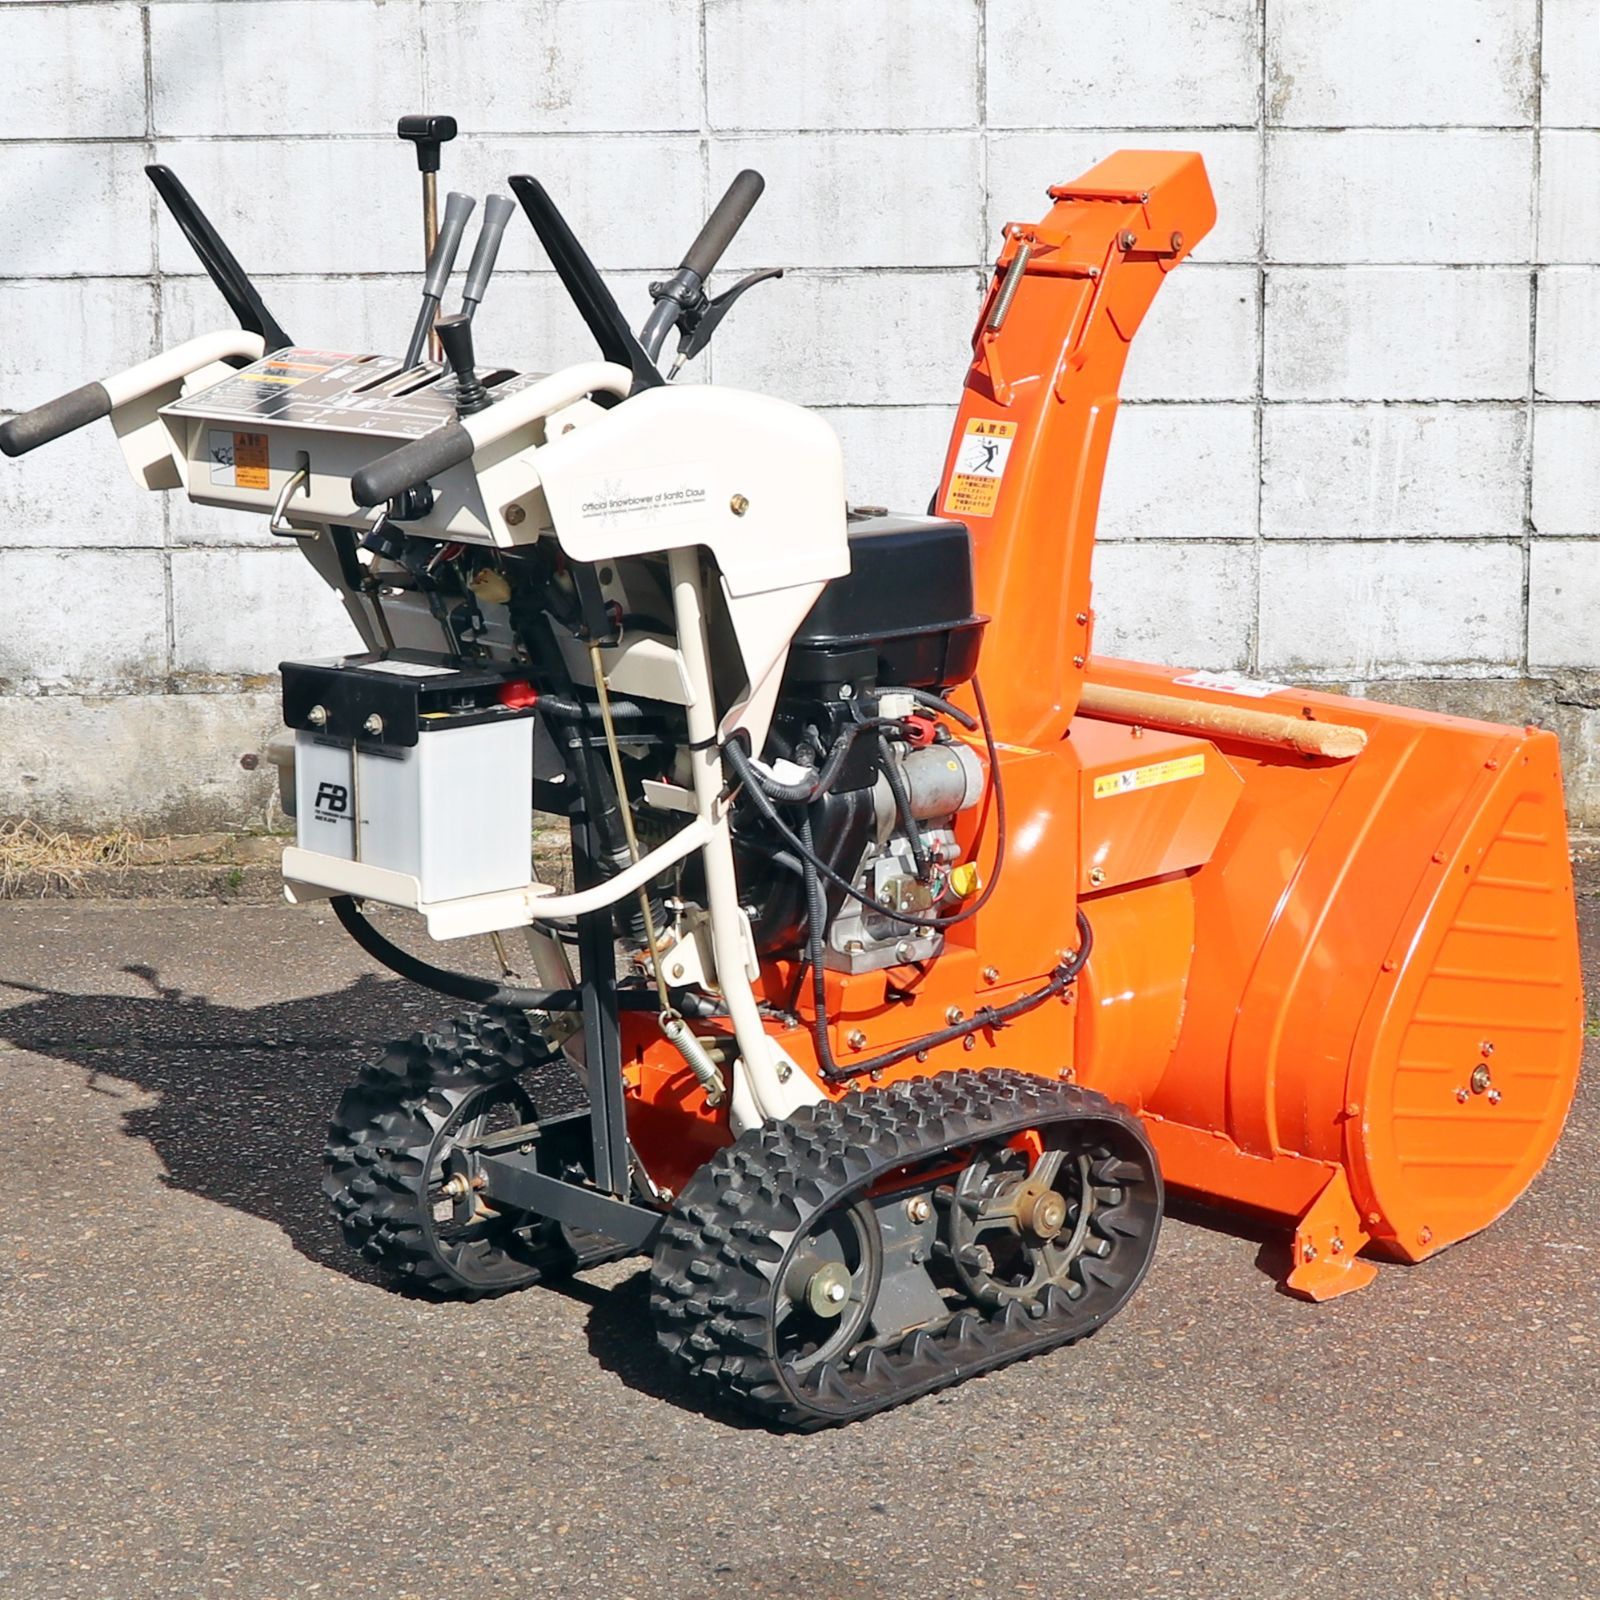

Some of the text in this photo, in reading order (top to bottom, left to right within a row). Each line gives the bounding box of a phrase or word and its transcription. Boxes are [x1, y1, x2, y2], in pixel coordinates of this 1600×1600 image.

[582, 502, 607, 511] Official
[609, 496, 653, 507] Snowblower
[663, 491, 684, 500] Santa
[685, 488, 705, 497] Claus
